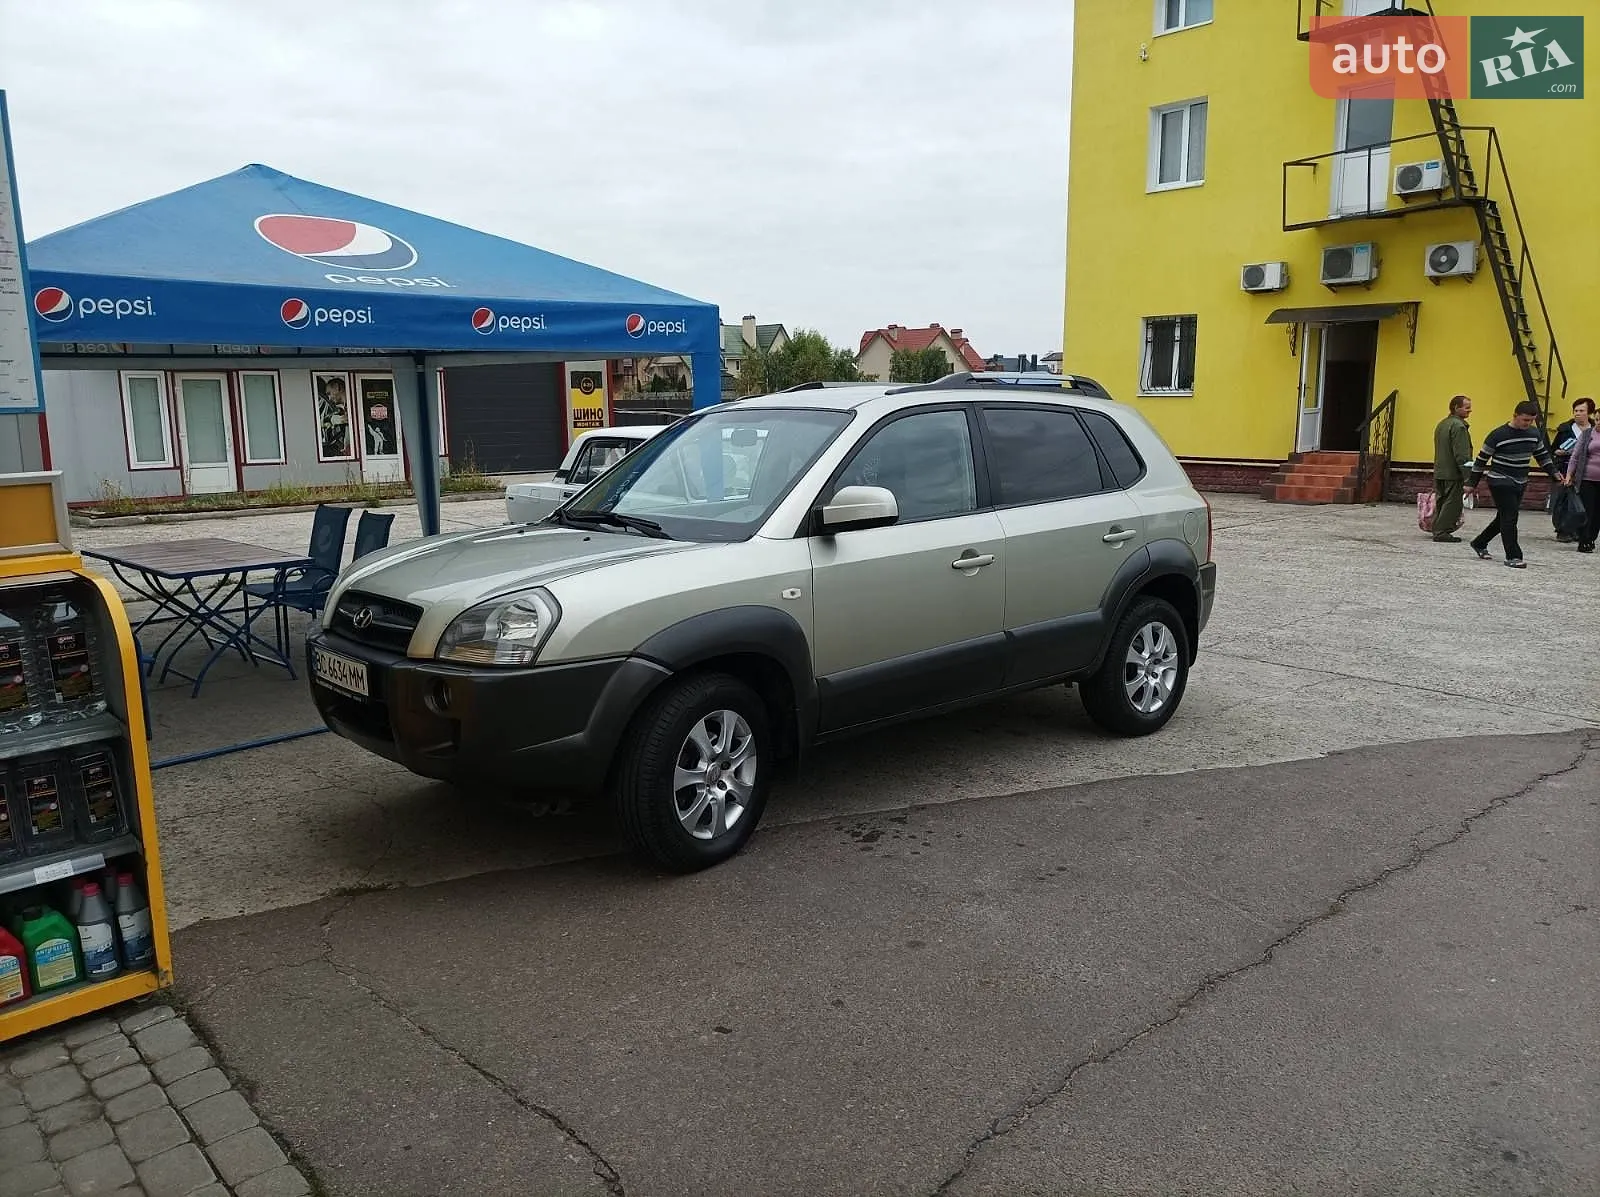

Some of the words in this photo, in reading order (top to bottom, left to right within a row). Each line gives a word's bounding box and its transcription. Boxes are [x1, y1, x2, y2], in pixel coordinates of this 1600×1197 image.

[324, 274, 451, 288] pepsi
[78, 296, 154, 320] pepsi
[315, 306, 373, 327] pepsi
[499, 314, 545, 332] pepsi
[647, 319, 686, 336] pepsi
[573, 408, 604, 421] ШИНО
[328, 657, 349, 685] 6634
[348, 665, 366, 690] MM
